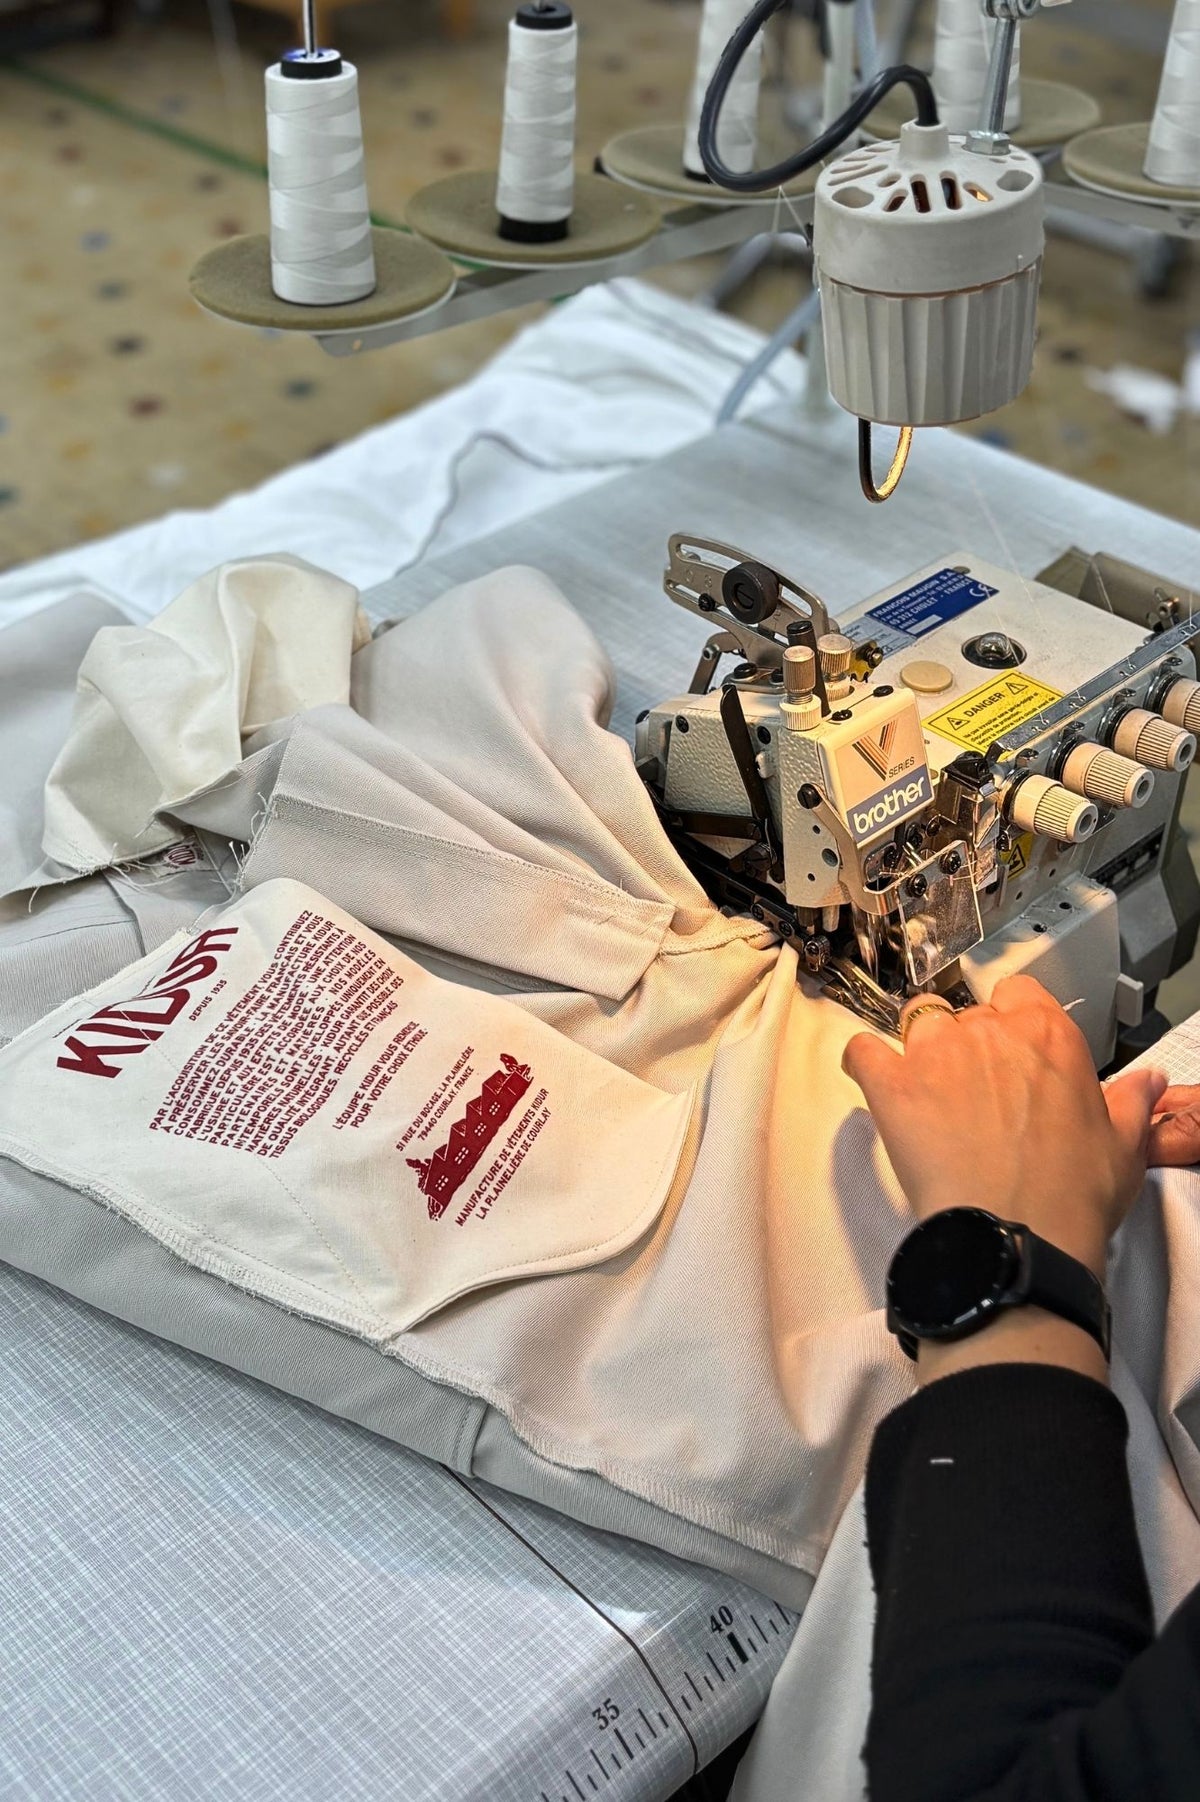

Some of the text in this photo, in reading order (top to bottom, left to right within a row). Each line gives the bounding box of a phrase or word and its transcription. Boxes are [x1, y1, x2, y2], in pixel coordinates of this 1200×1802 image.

[889, 757, 915, 778] SERIES
[964, 692, 1005, 717] DANGER
[853, 776, 924, 834] brother
[57, 927, 239, 1078] KIDUR
[150, 1108, 169, 1131] PAR
[163, 1044, 209, 1107] L'ACQUISITION
[204, 1032, 219, 1044] DE
[214, 1022, 229, 1033] CE
[258, 962, 279, 984] VOUS
[275, 910, 313, 960] CONTRIBUEZ
[168, 1059, 212, 1123] PRÉSERVER
[206, 1042, 225, 1059] LES
[221, 993, 271, 1042] SAVOIR-FAIRE
[265, 946, 299, 994] FRANÇAIS
[293, 933, 307, 945] ET
[303, 915, 324, 933] VOUS
[174, 920, 336, 1136] CONSOMMEZ DURABLE LA MANUFACTURE KIDUR
[185, 1090, 222, 1139] FABRIQUE
[216, 1058, 244, 1089] DEPUIS
[239, 1037, 259, 1059] 1935
[255, 1022, 274, 1038] DES
[269, 973, 307, 1023] VÊTEMENTS
[302, 932, 341, 973] RÉSISTANTS
[188, 979, 227, 1021] DEPUIS 1935
[197, 933, 357, 1142] L'USURE ET AUX EFFETS DE MODE UNE ATTENTION
[209, 941, 367, 1145] PARTICULIÈRE EST ACCORDÉE AUX CHOIX DE NOS
[221, 1076, 278, 1147] PARTENAIRES
[273, 1058, 289, 1075] ET
[286, 1006, 326, 1057] MATIÈRES
[329, 977, 348, 996] NOS
[233, 957, 386, 1150] INTEMPORELS SONT DÉVELOPPÉS UNIQUEMENT EN
[245, 966, 395, 1153] MATIÈRES NATURELLES KIDUR GARANTIT DES CHOIX
[257, 1142, 274, 1156] DE
[269, 1105, 301, 1141] QUALITÉ
[334, 1019, 361, 1053] AUTANT
[390, 975, 404, 990] DES
[269, 1126, 298, 1158] TISSUS
[334, 1030, 370, 1075] RECYCLÉS
[363, 1021, 376, 1032] ET
[371, 1000, 398, 1025] FRANÇAIS
[333, 1091, 366, 1130] L'ÉQUIPE
[359, 1064, 384, 1091] KIDUR
[377, 1043, 399, 1065] VOUS
[350, 1102, 374, 1128] POUR
[367, 1073, 393, 1101] VOTRE
[388, 1051, 410, 1075] CHOIX
[395, 1141, 406, 1152] 51
[401, 1126, 417, 1144] RUE
[412, 1115, 424, 1129] DU
[438, 1082, 449, 1093] LA
[445, 1046, 475, 1084] PLAINELIÈRE
[418, 1117, 438, 1141] 79440
[455, 1065, 474, 1091] FRANCE
[455, 1088, 549, 1227] MANUFACTURE DE VÊTEMENTS KIDUR
[475, 1106, 552, 1220] LA PLAINELIÈRE DE COURLAY
[708, 1606, 734, 1634] 40
[592, 1698, 621, 1731] 35
